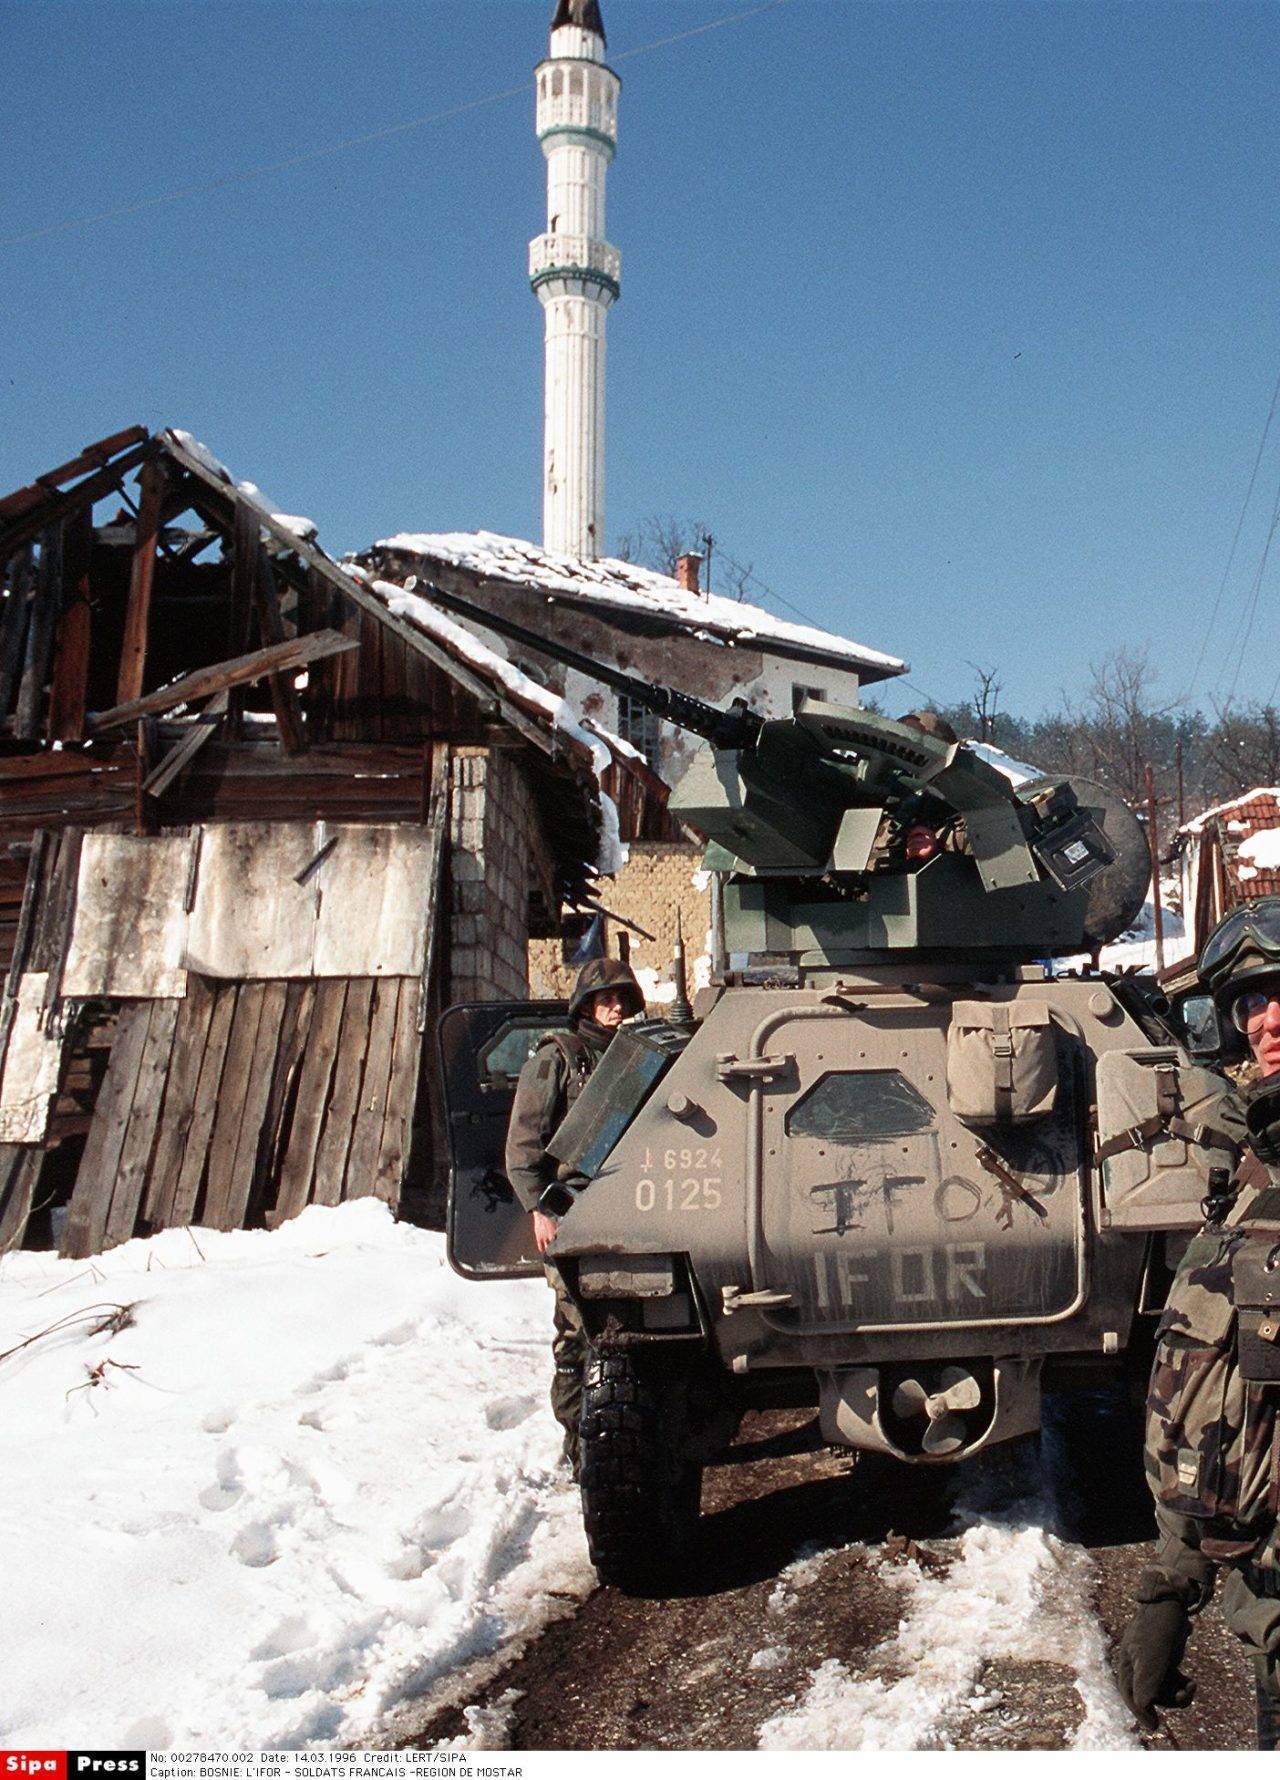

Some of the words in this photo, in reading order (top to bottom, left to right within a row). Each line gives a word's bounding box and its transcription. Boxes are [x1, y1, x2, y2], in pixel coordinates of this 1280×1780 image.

[664, 1148, 723, 1169] 6924
[635, 1178, 722, 1211] 0125
[814, 1240, 987, 1307] IFOR
